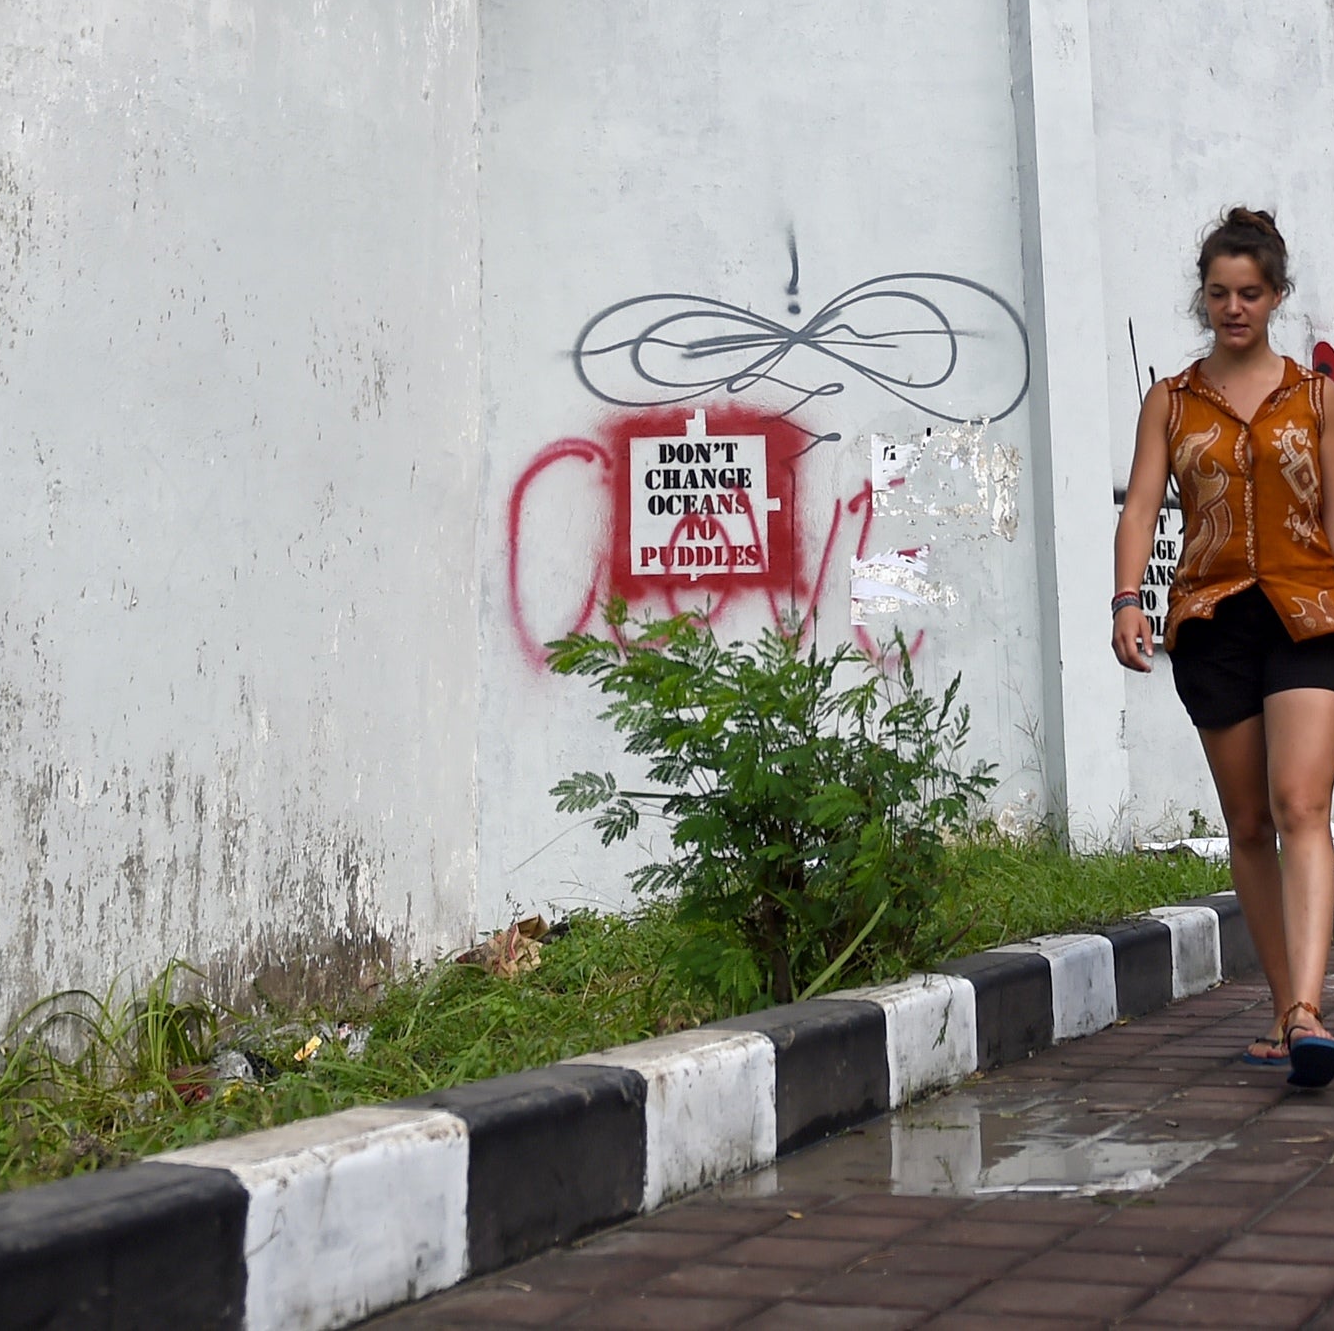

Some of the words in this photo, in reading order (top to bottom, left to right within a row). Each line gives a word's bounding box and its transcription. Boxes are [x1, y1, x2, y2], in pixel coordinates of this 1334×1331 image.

[658, 442, 738, 464] DON'T
[645, 468, 752, 490] CHANGE
[647, 494, 749, 516] OCEANS
[683, 519, 717, 540] TO
[640, 545, 761, 567] PUDDLES
